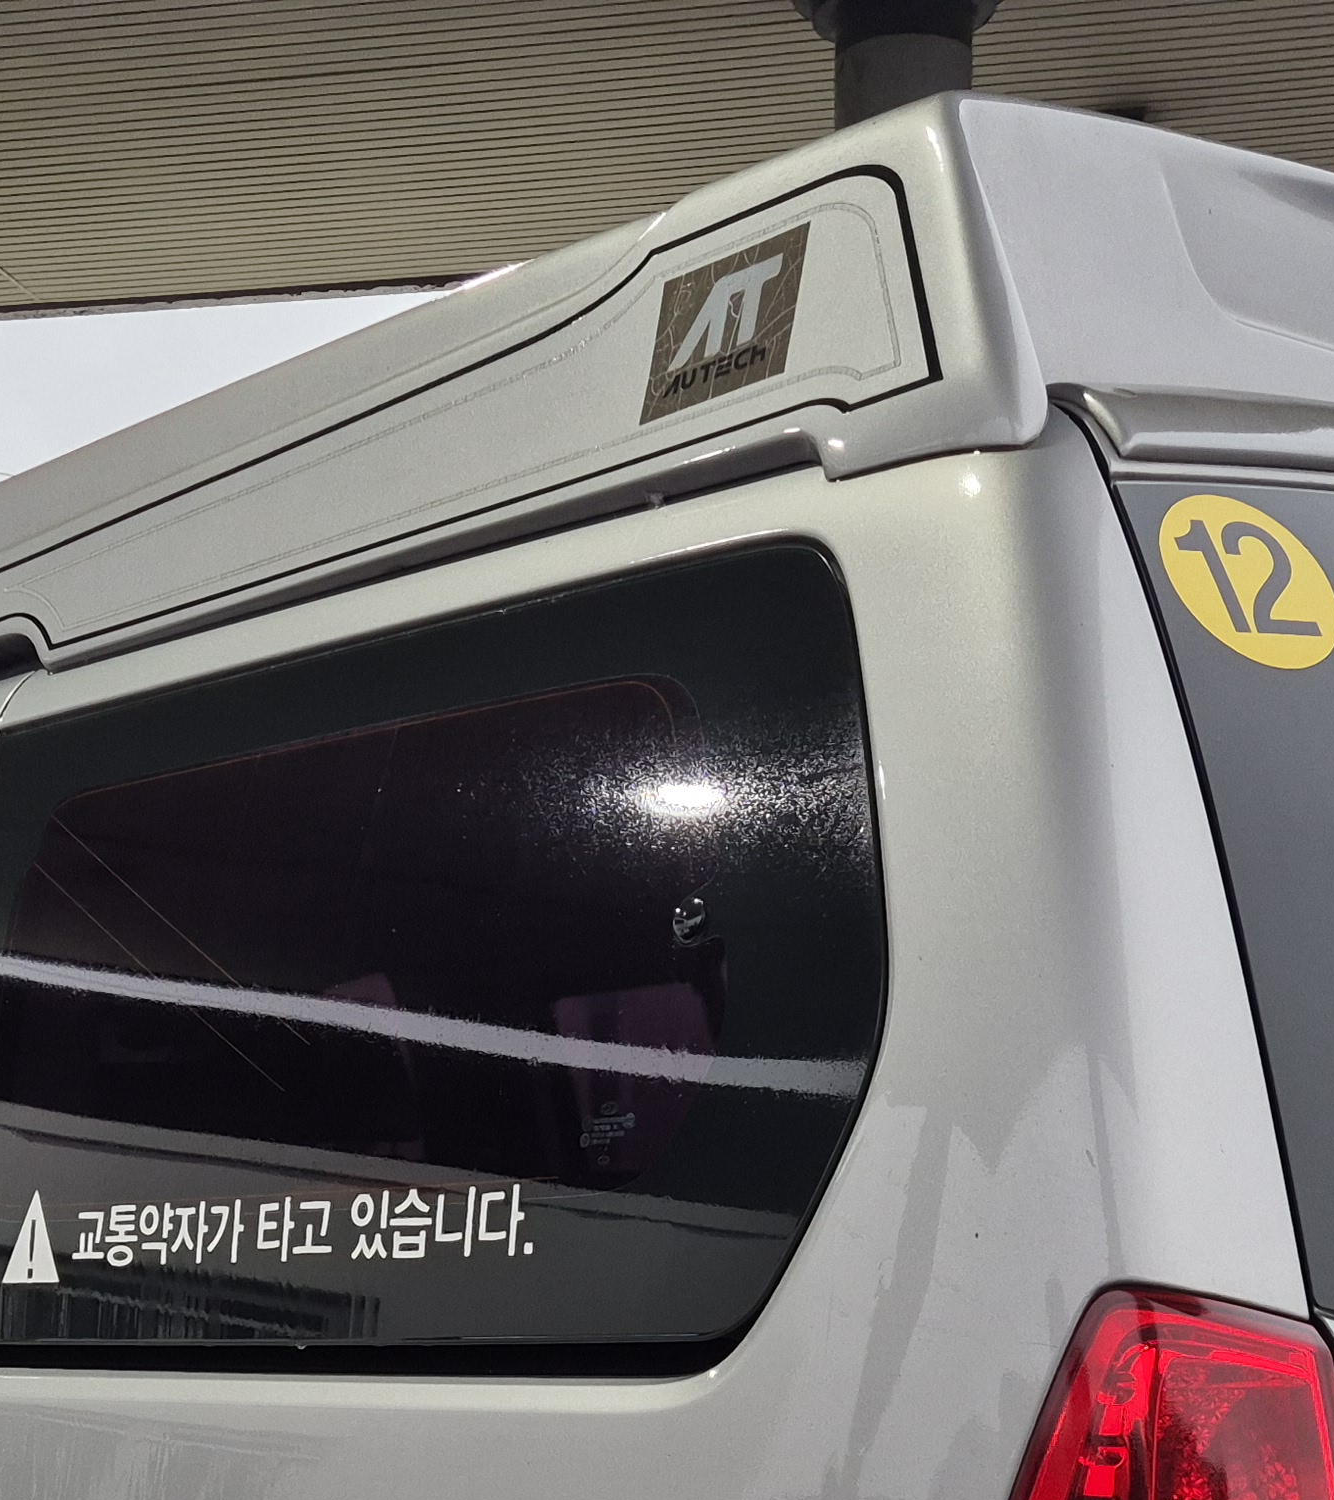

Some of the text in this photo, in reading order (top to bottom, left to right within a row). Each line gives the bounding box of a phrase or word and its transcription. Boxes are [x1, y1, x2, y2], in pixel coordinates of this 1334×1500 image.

[662, 344, 767, 398] AUTECH
[1174, 519, 1323, 637] 12
[72, 1184, 533, 1267] 교통약자가 타고 있습니다.
